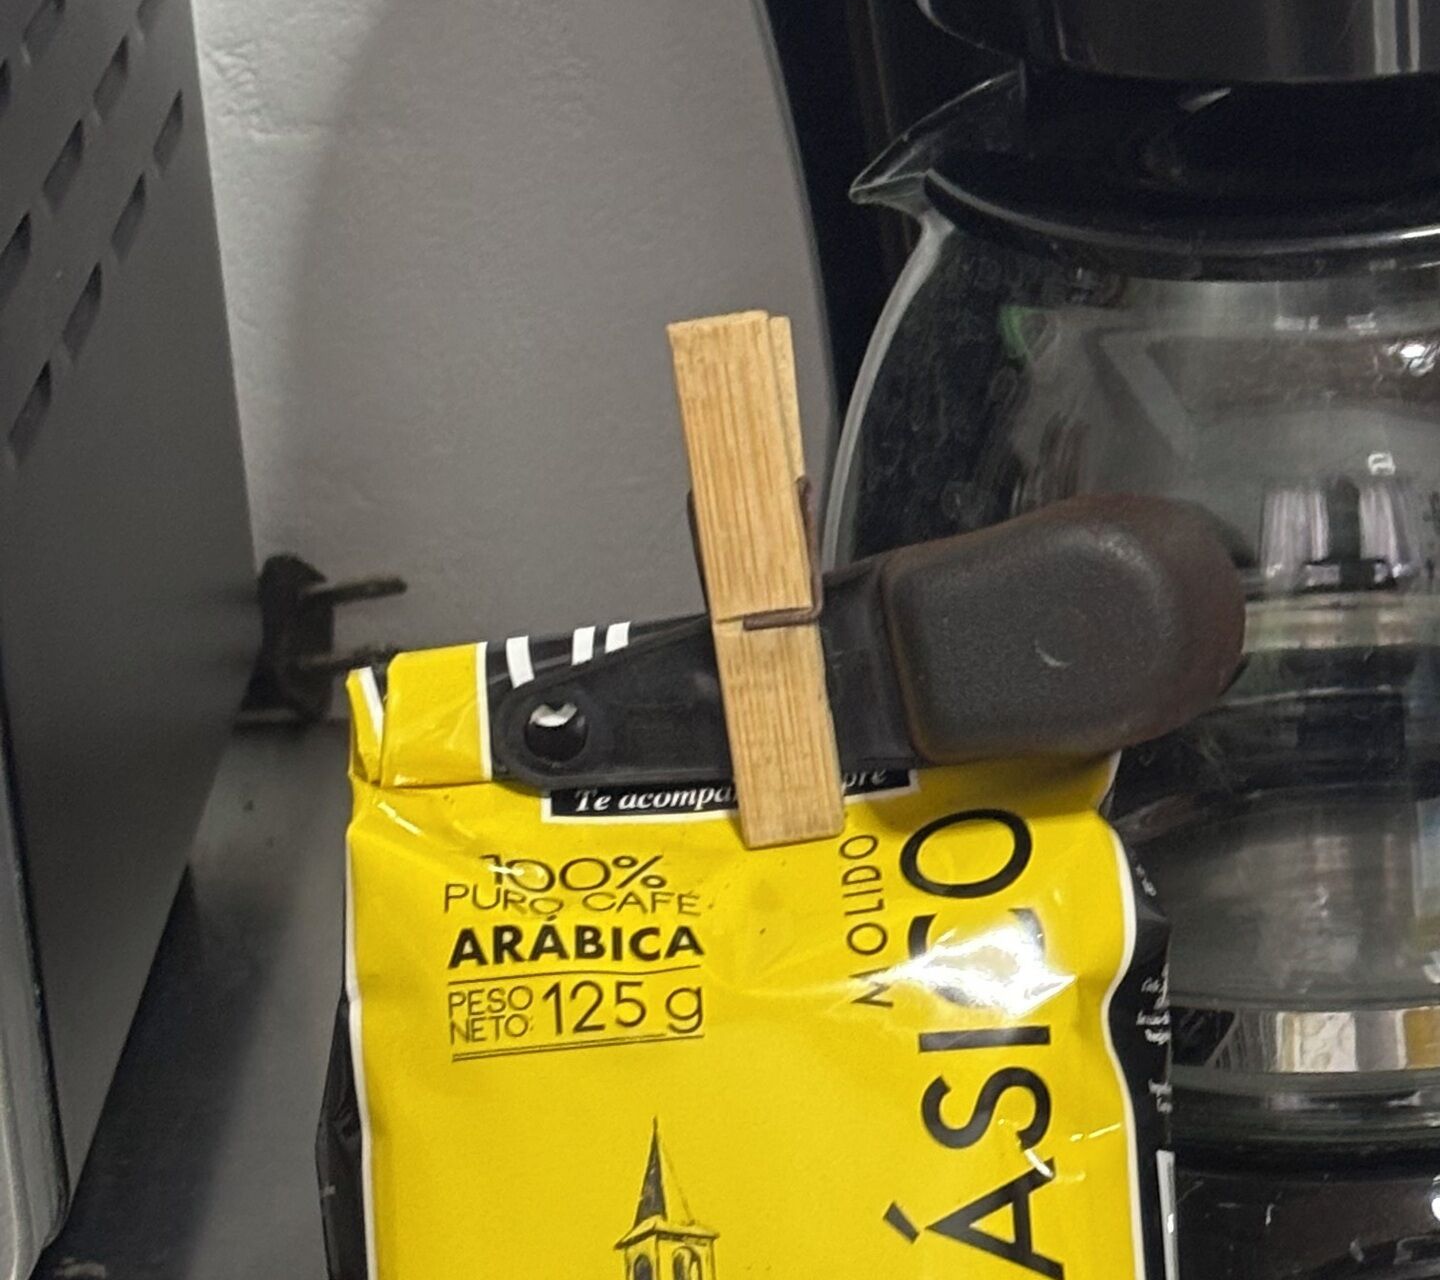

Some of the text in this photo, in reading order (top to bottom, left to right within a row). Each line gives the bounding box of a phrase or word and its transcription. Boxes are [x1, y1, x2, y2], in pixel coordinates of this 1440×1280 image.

[574, 783, 738, 812] Te acompa
[478, 854, 668, 893] 100%
[443, 883, 702, 917] PURO CAFÉ
[838, 834, 894, 1008] MOLIDO
[447, 914, 705, 969] ARÁBICA
[447, 984, 534, 1018] PESO
[541, 979, 705, 1036] 125 g
